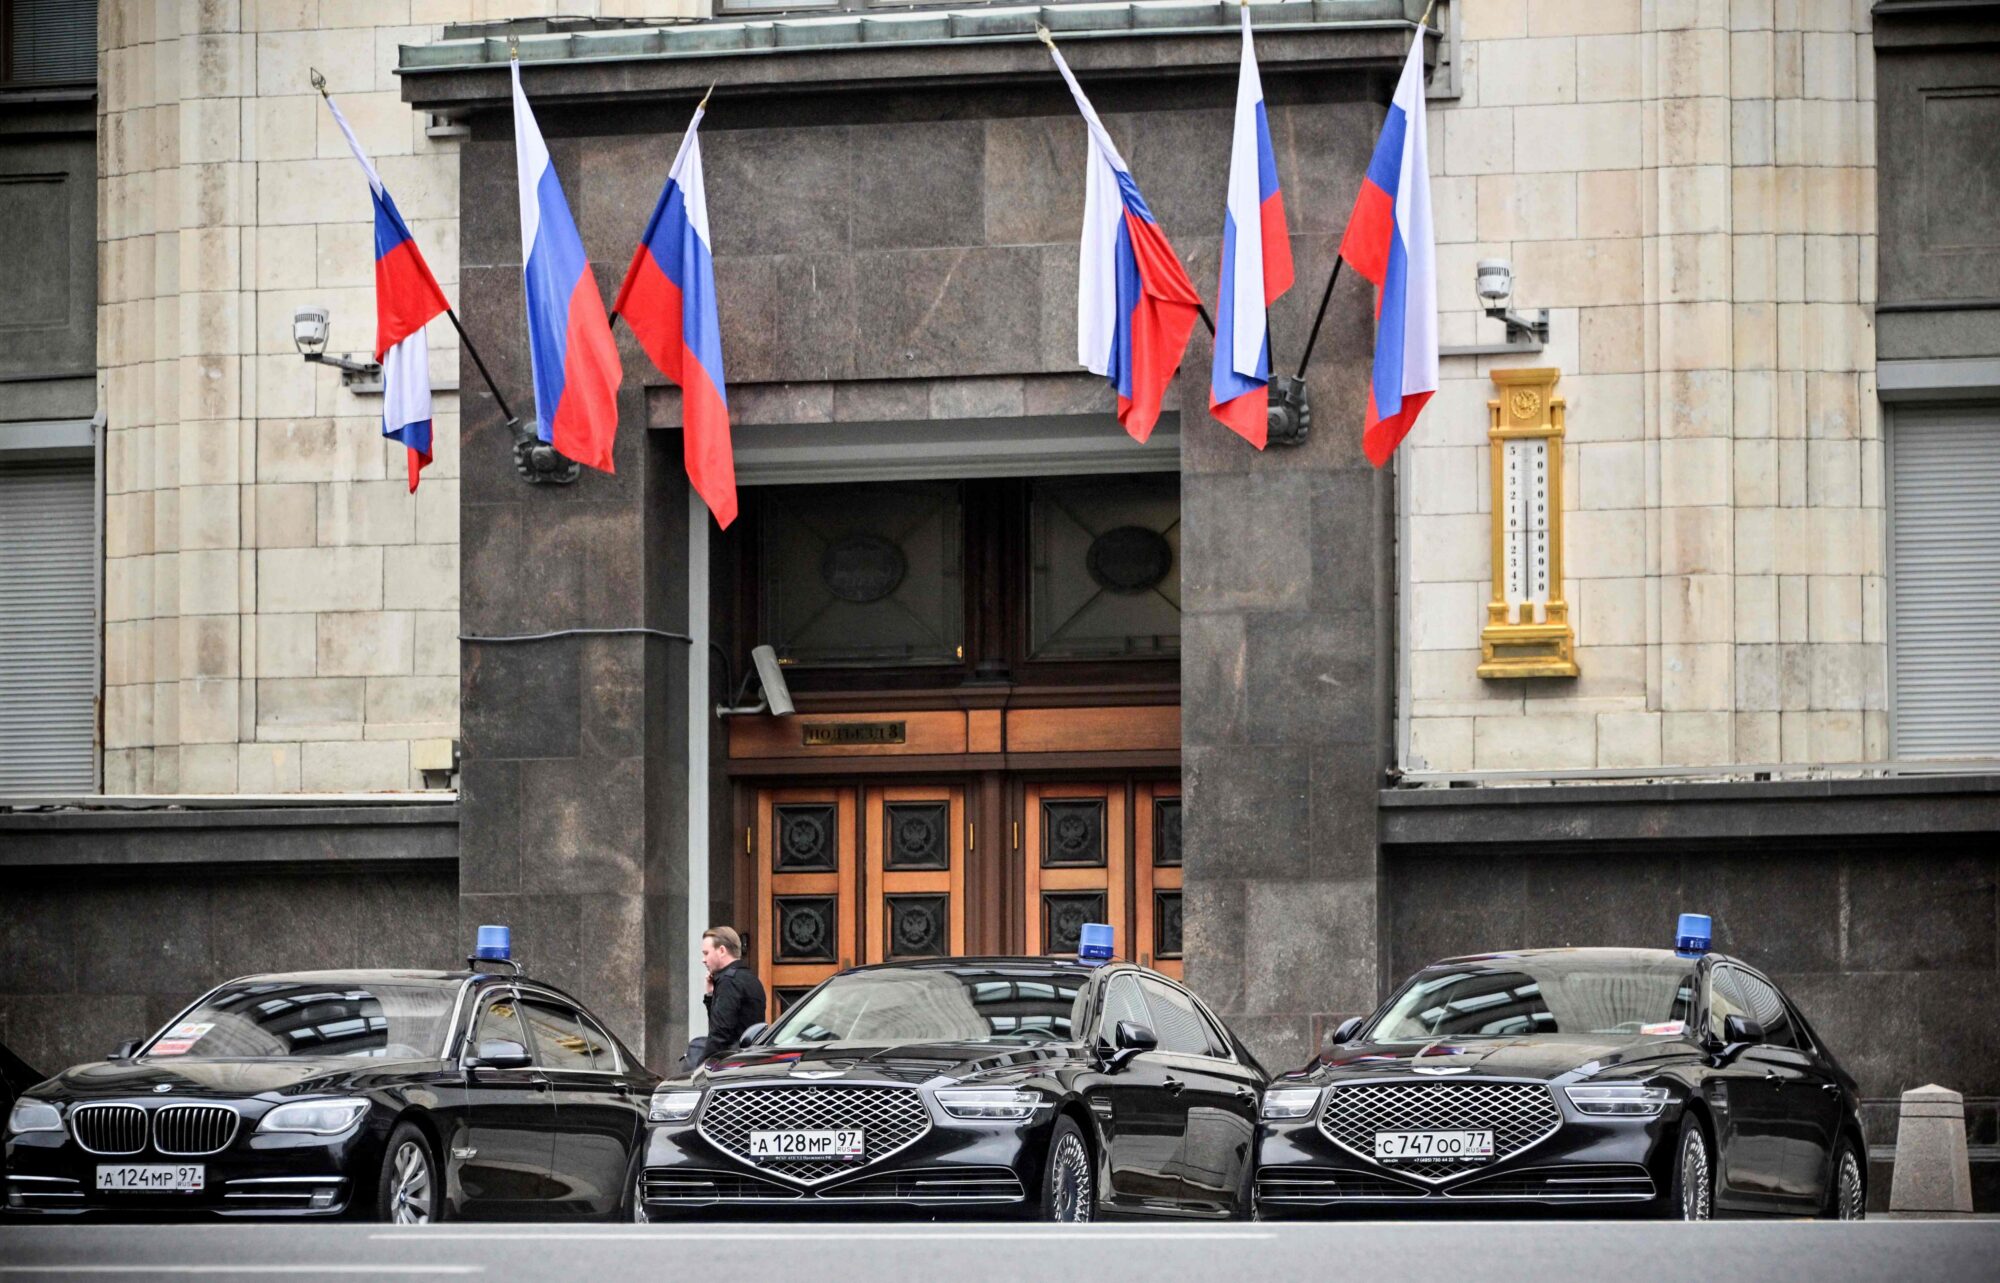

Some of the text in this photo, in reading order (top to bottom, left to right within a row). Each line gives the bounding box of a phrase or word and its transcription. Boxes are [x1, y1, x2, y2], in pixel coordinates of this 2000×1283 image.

[888, 724, 898, 739] 8
[838, 1132, 856, 1147] 97
[1467, 1133, 1486, 1147] 77
[179, 1168, 196, 1181] 97
